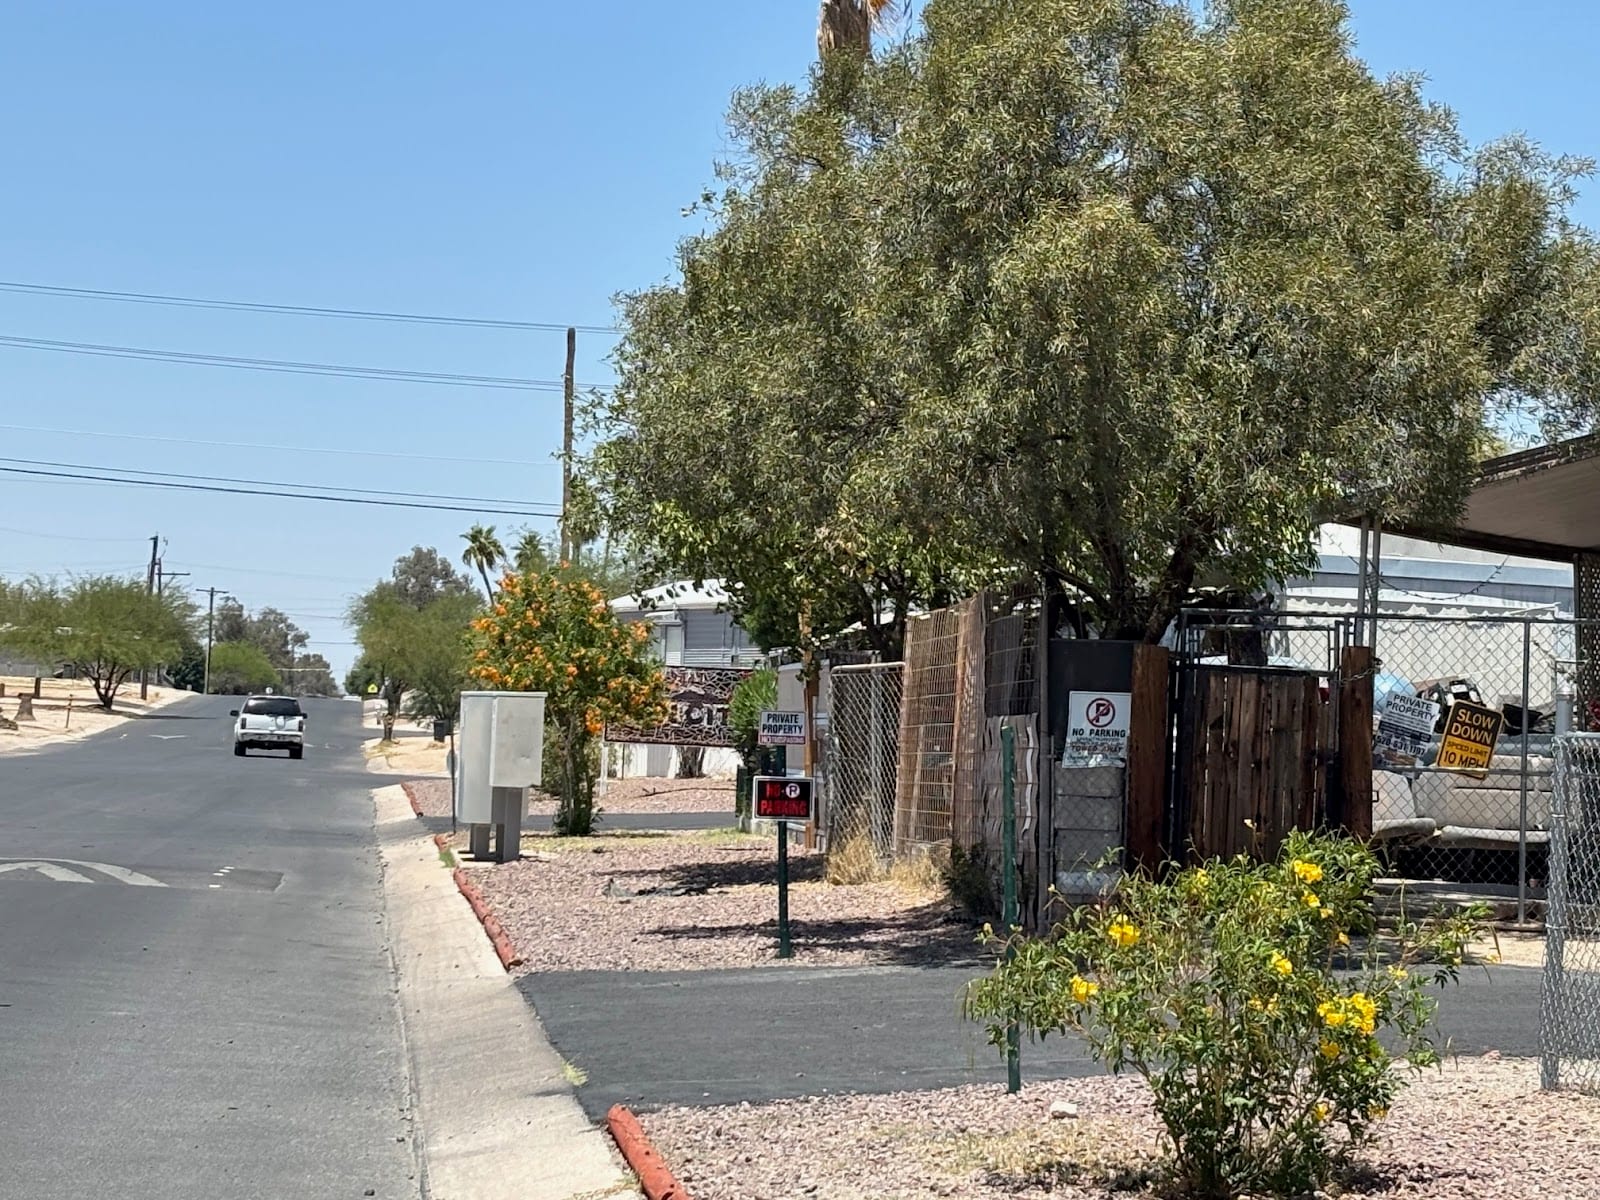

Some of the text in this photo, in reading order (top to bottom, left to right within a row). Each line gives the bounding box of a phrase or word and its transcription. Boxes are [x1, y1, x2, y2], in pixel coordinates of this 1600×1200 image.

[1386, 701, 1435, 721] PROPERTY
[1394, 695, 1433, 712] PRIVATE
[766, 713, 799, 723] PRIVATE
[1456, 709, 1496, 729] SLOW
[762, 724, 803, 734] PROPERTY
[1072, 728, 1126, 738] NO PARKING
[1451, 722, 1493, 744] DOWN
[761, 736, 771, 744] NO
[1447, 741, 1489, 757] SPEED LIMIT
[1443, 751, 1486, 769] 10 MPH
[766, 783, 781, 798] NO
[761, 799, 807, 815] PARKING
